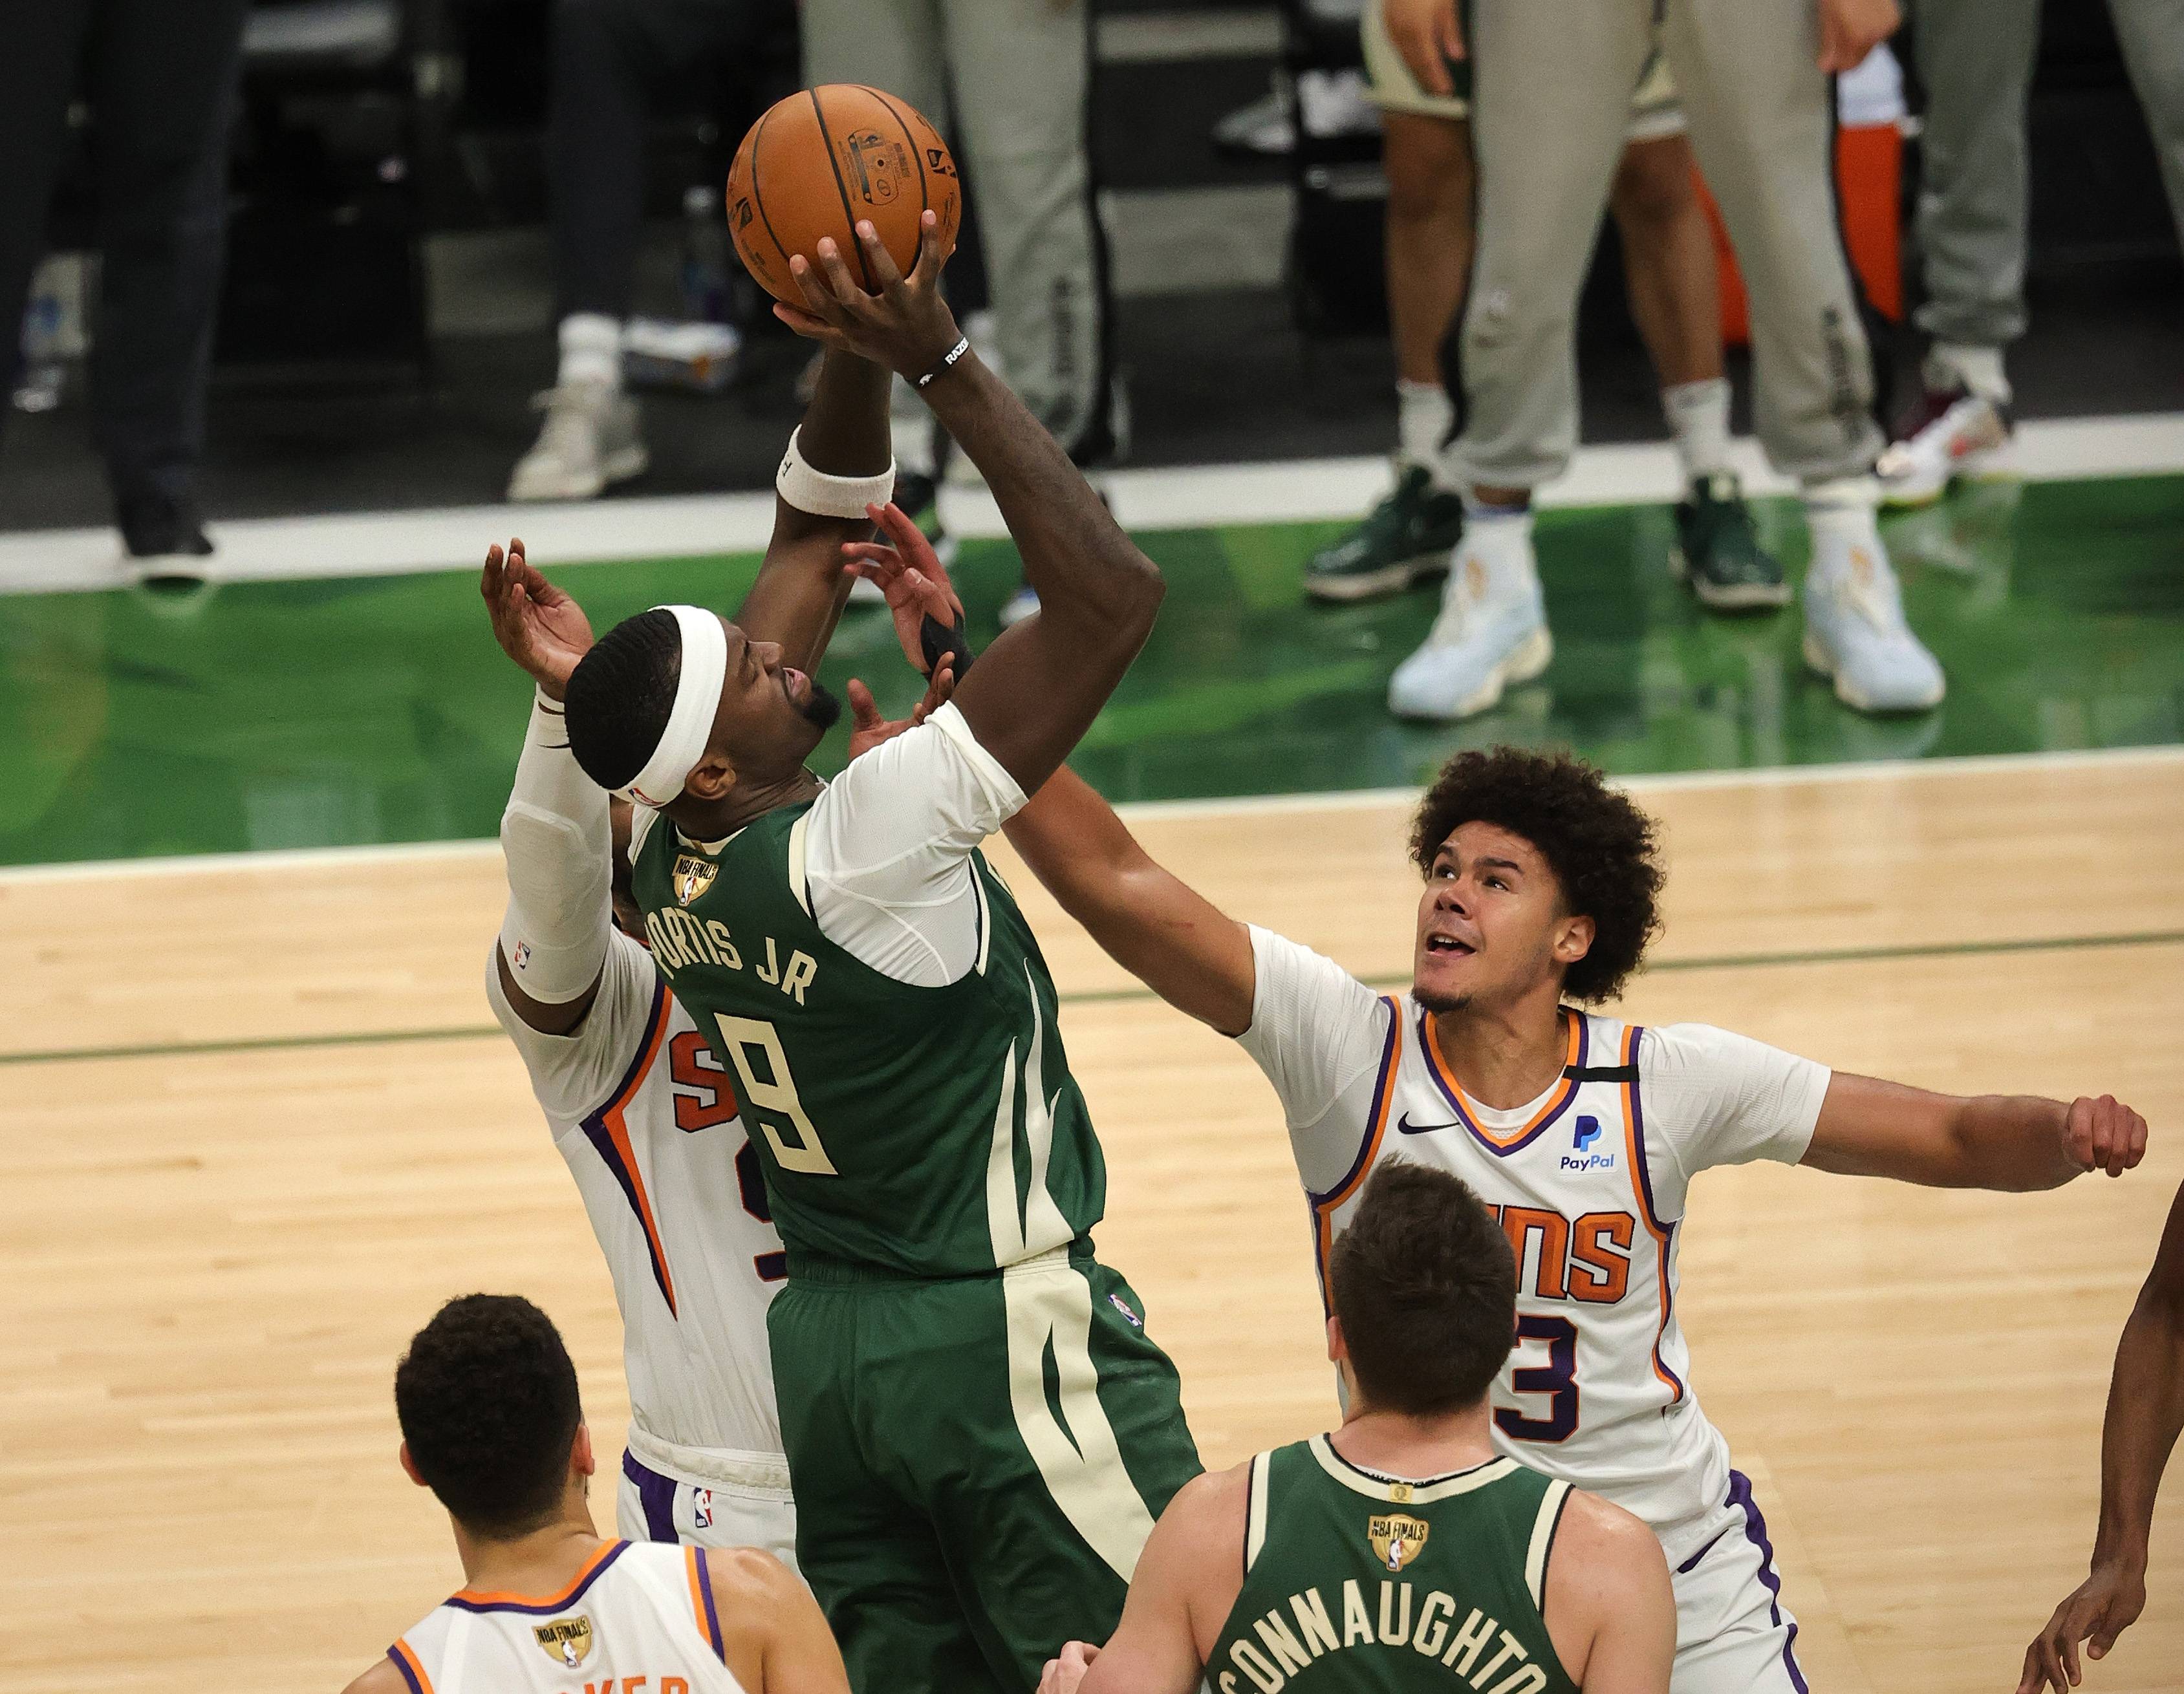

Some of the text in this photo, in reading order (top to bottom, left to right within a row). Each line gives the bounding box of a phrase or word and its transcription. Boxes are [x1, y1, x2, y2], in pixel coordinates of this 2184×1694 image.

[676, 859, 694, 875] NBA
[755, 936, 818, 1006] JR
[714, 1012, 839, 1175] 9
[1560, 1153, 1615, 1171] PayPal
[1487, 1203, 1636, 1304] NS
[1494, 1313, 1579, 1444] 3
[1371, 1520, 1425, 1541] NBA FINALS
[535, 1618, 589, 1644] NBA FINALS
